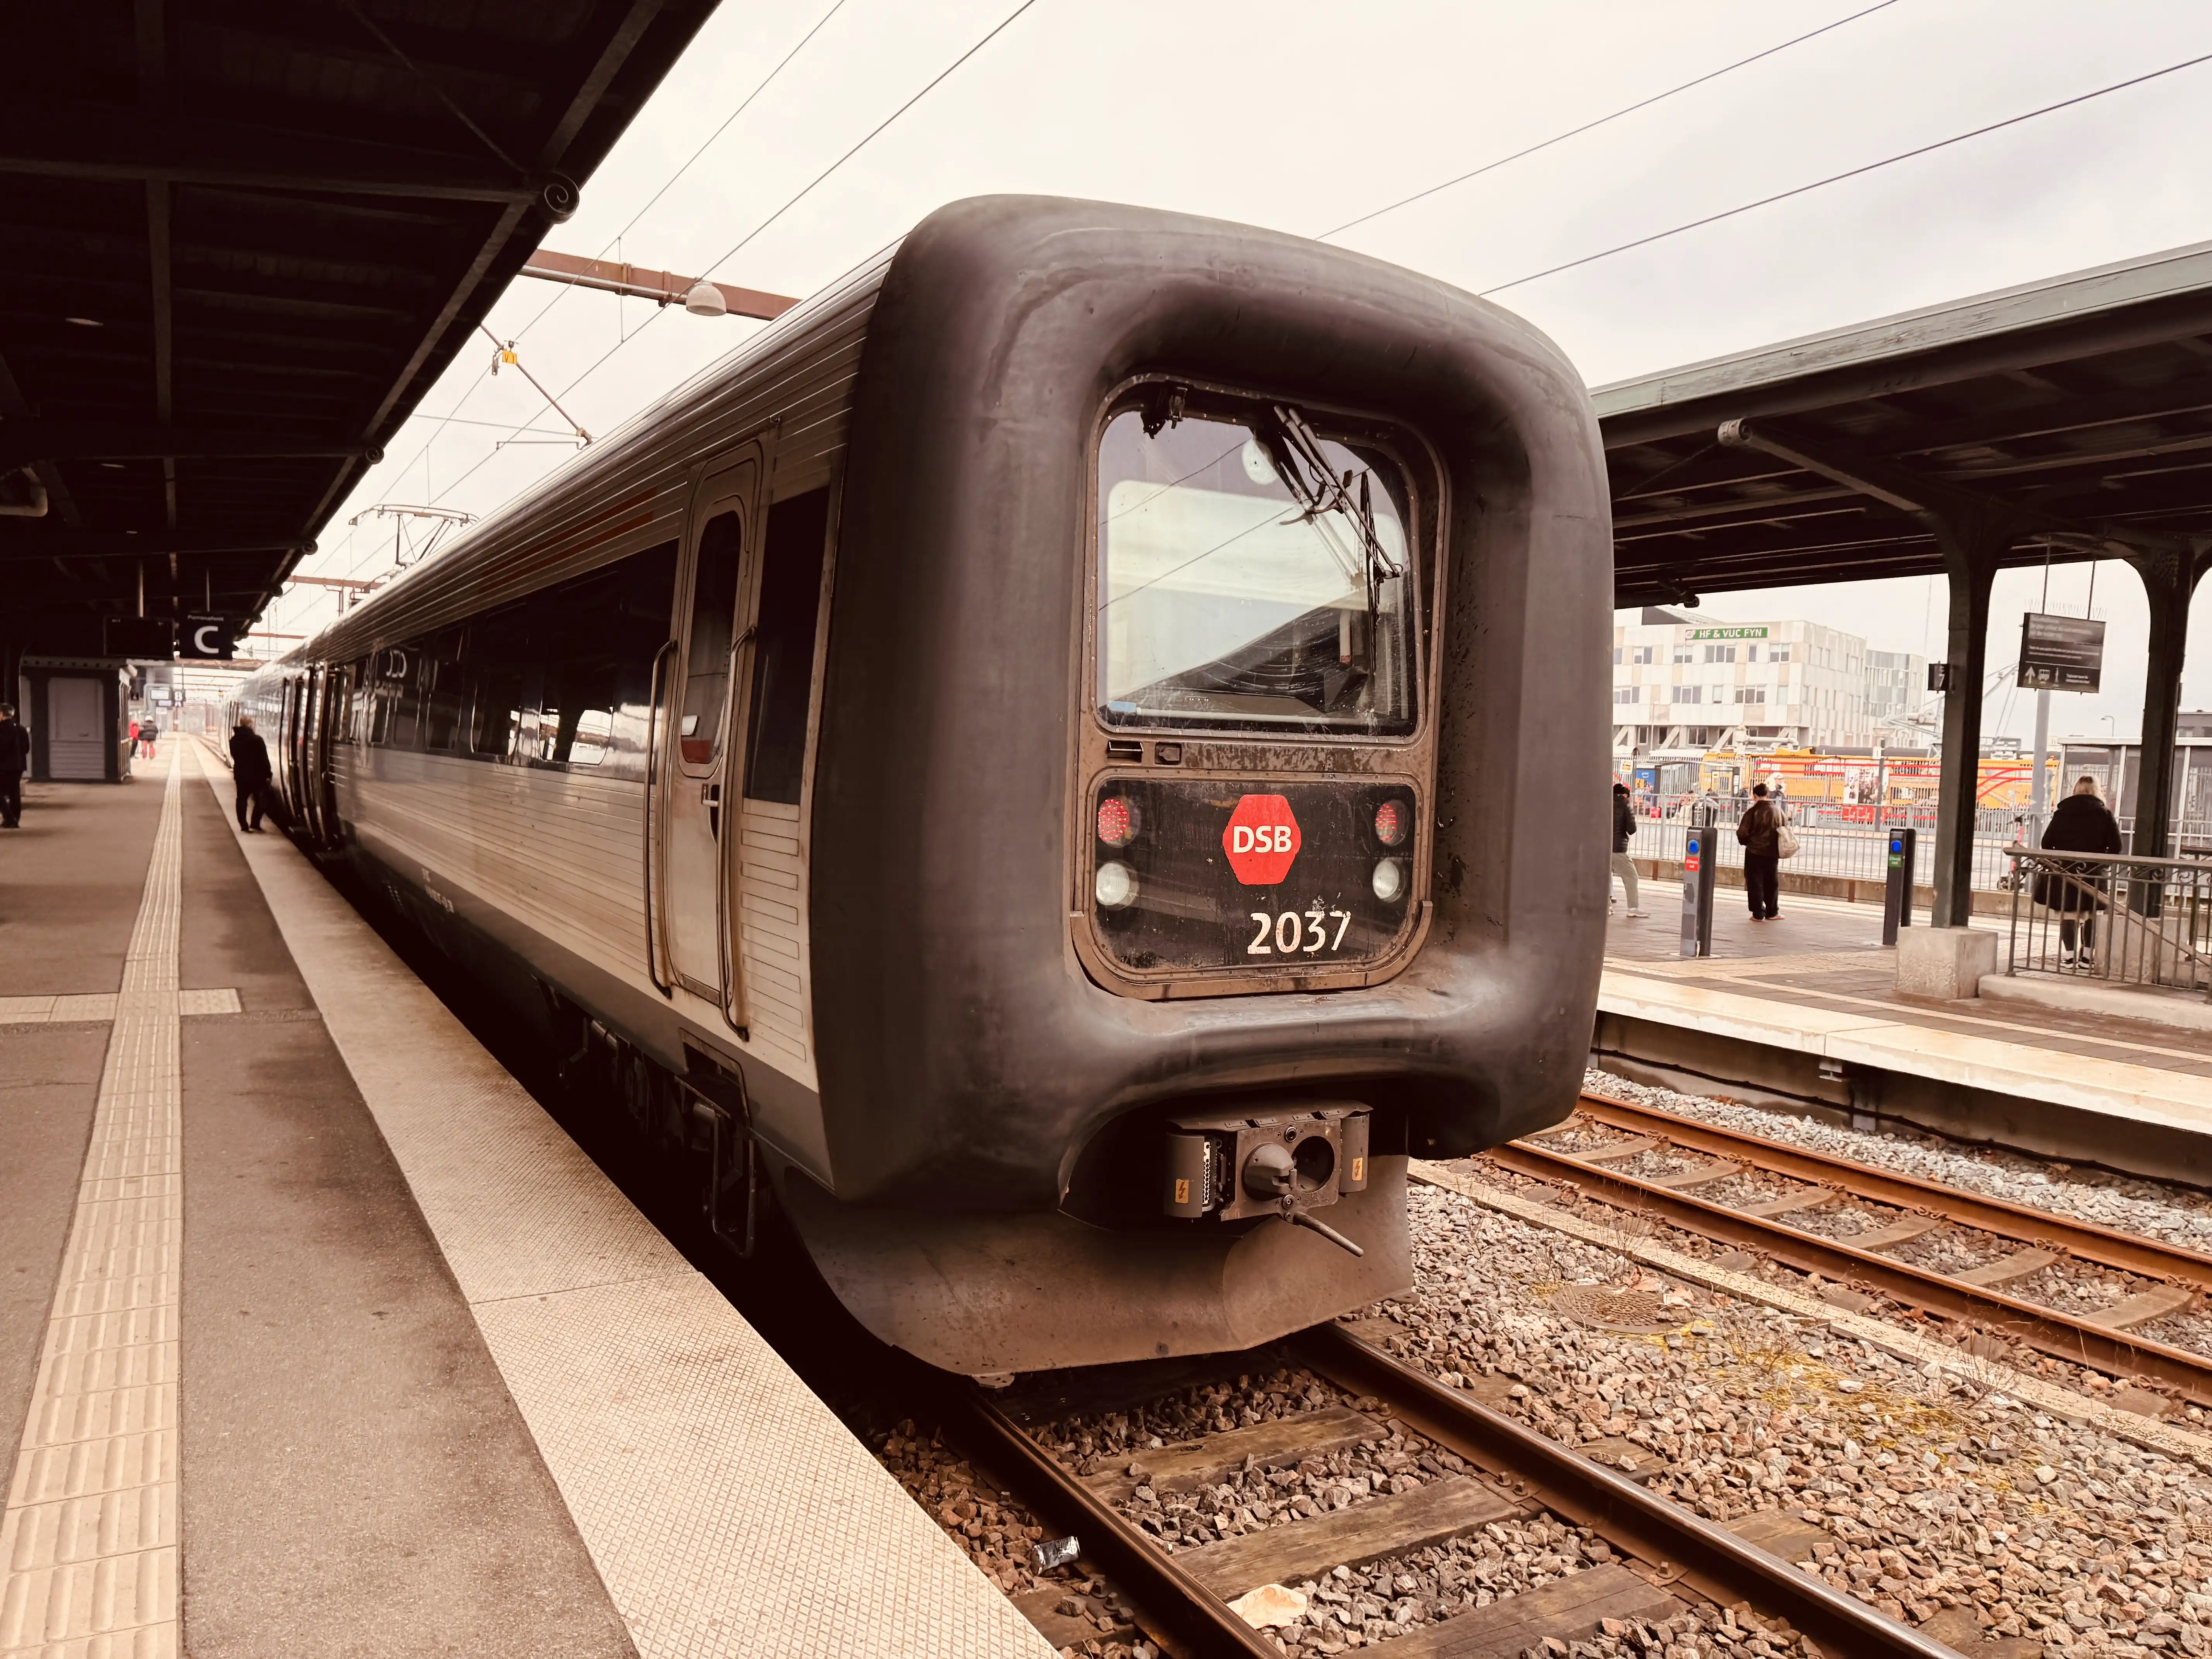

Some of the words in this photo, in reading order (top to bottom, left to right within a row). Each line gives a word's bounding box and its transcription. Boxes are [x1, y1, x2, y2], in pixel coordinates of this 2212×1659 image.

[194, 625, 219, 654] C
[1699, 630, 1711, 638] HF
[1713, 630, 1720, 638] &
[1723, 629, 1741, 637] VUC
[1744, 629, 1762, 637] FYN
[1233, 825, 1292, 853] DSB
[1247, 910, 1351, 954] 2037
